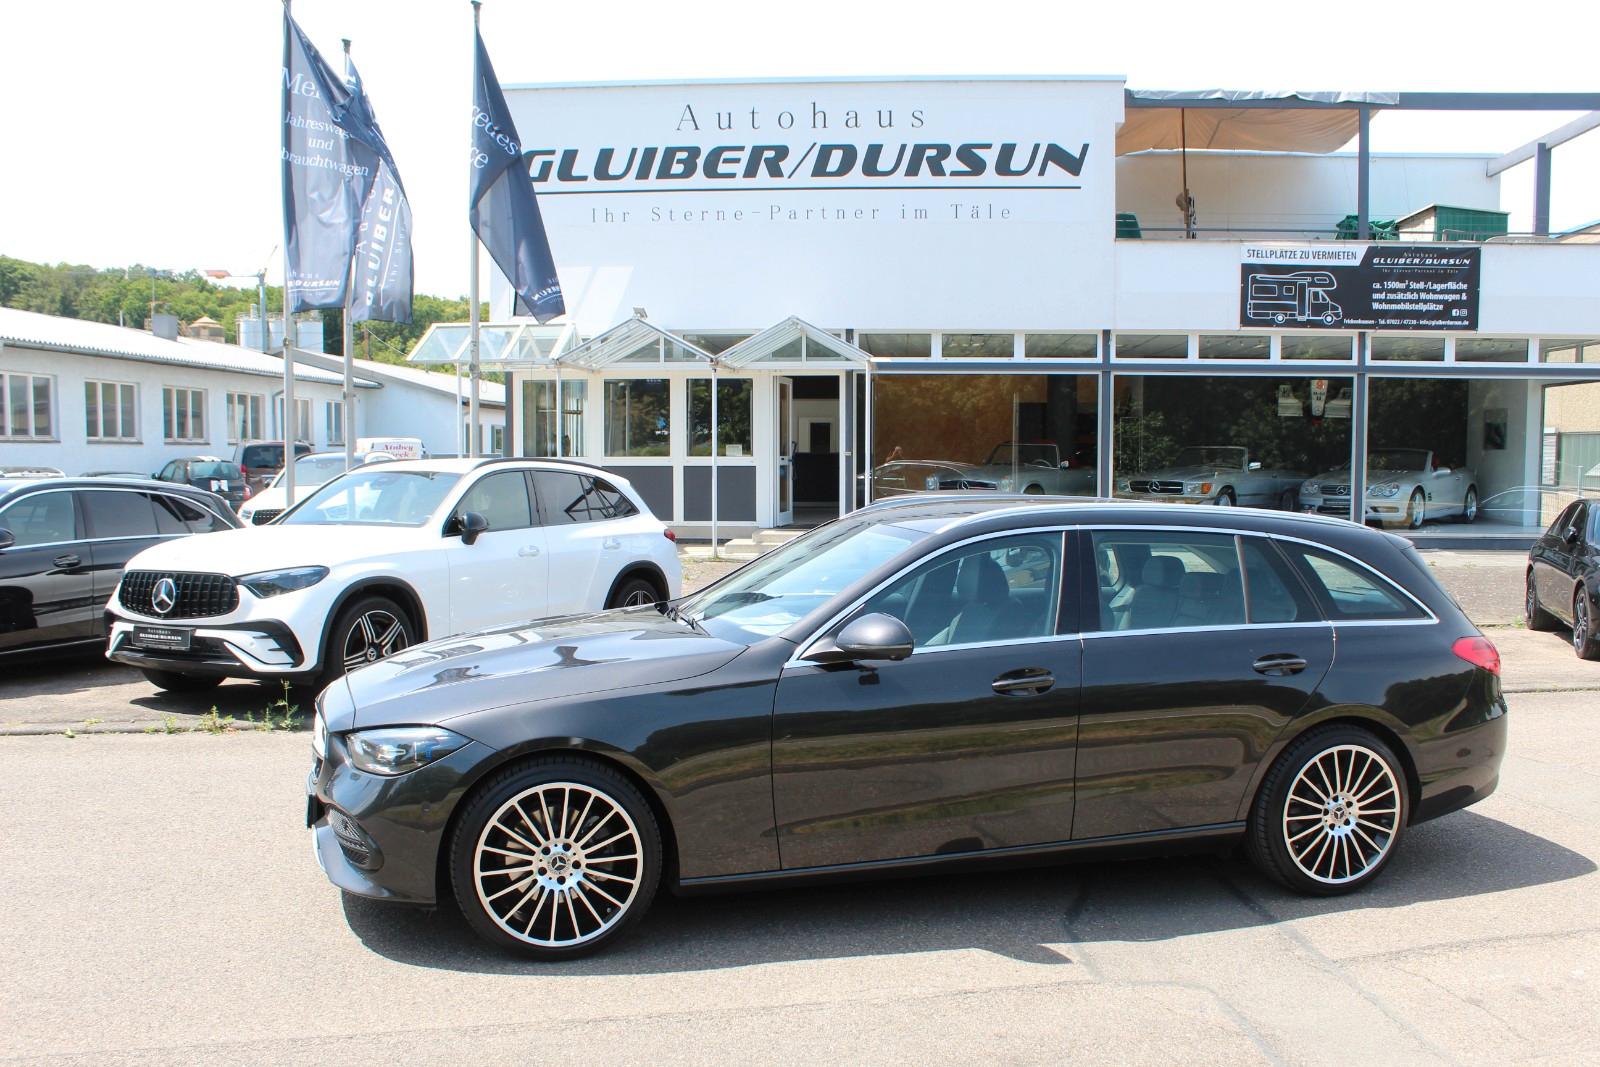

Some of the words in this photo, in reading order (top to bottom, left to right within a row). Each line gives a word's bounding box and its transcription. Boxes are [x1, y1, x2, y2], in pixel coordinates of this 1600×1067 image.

[676, 102, 924, 131] Autohaus
[308, 138, 334, 151] und
[592, 207, 631, 223] Ihr
[651, 203, 880, 222] Sterne-Partner
[901, 204, 929, 220] im
[950, 203, 1010, 220] Täle
[1247, 248, 1298, 260] STELLPLÄTZE
[1299, 250, 1310, 260] ZU
[1312, 250, 1357, 261] VERMIETEN
[1373, 257, 1471, 265] GLUIBER/DURSUN
[1409, 281, 1468, 291] Stell-/Lagerfläche
[1372, 292, 1385, 300] und
[1386, 292, 1418, 300] zusätzlich
[1419, 292, 1460, 301] Wohnwagen
[1461, 292, 1467, 300] &
[1372, 302, 1444, 312] Wohnmobilstellplätze
